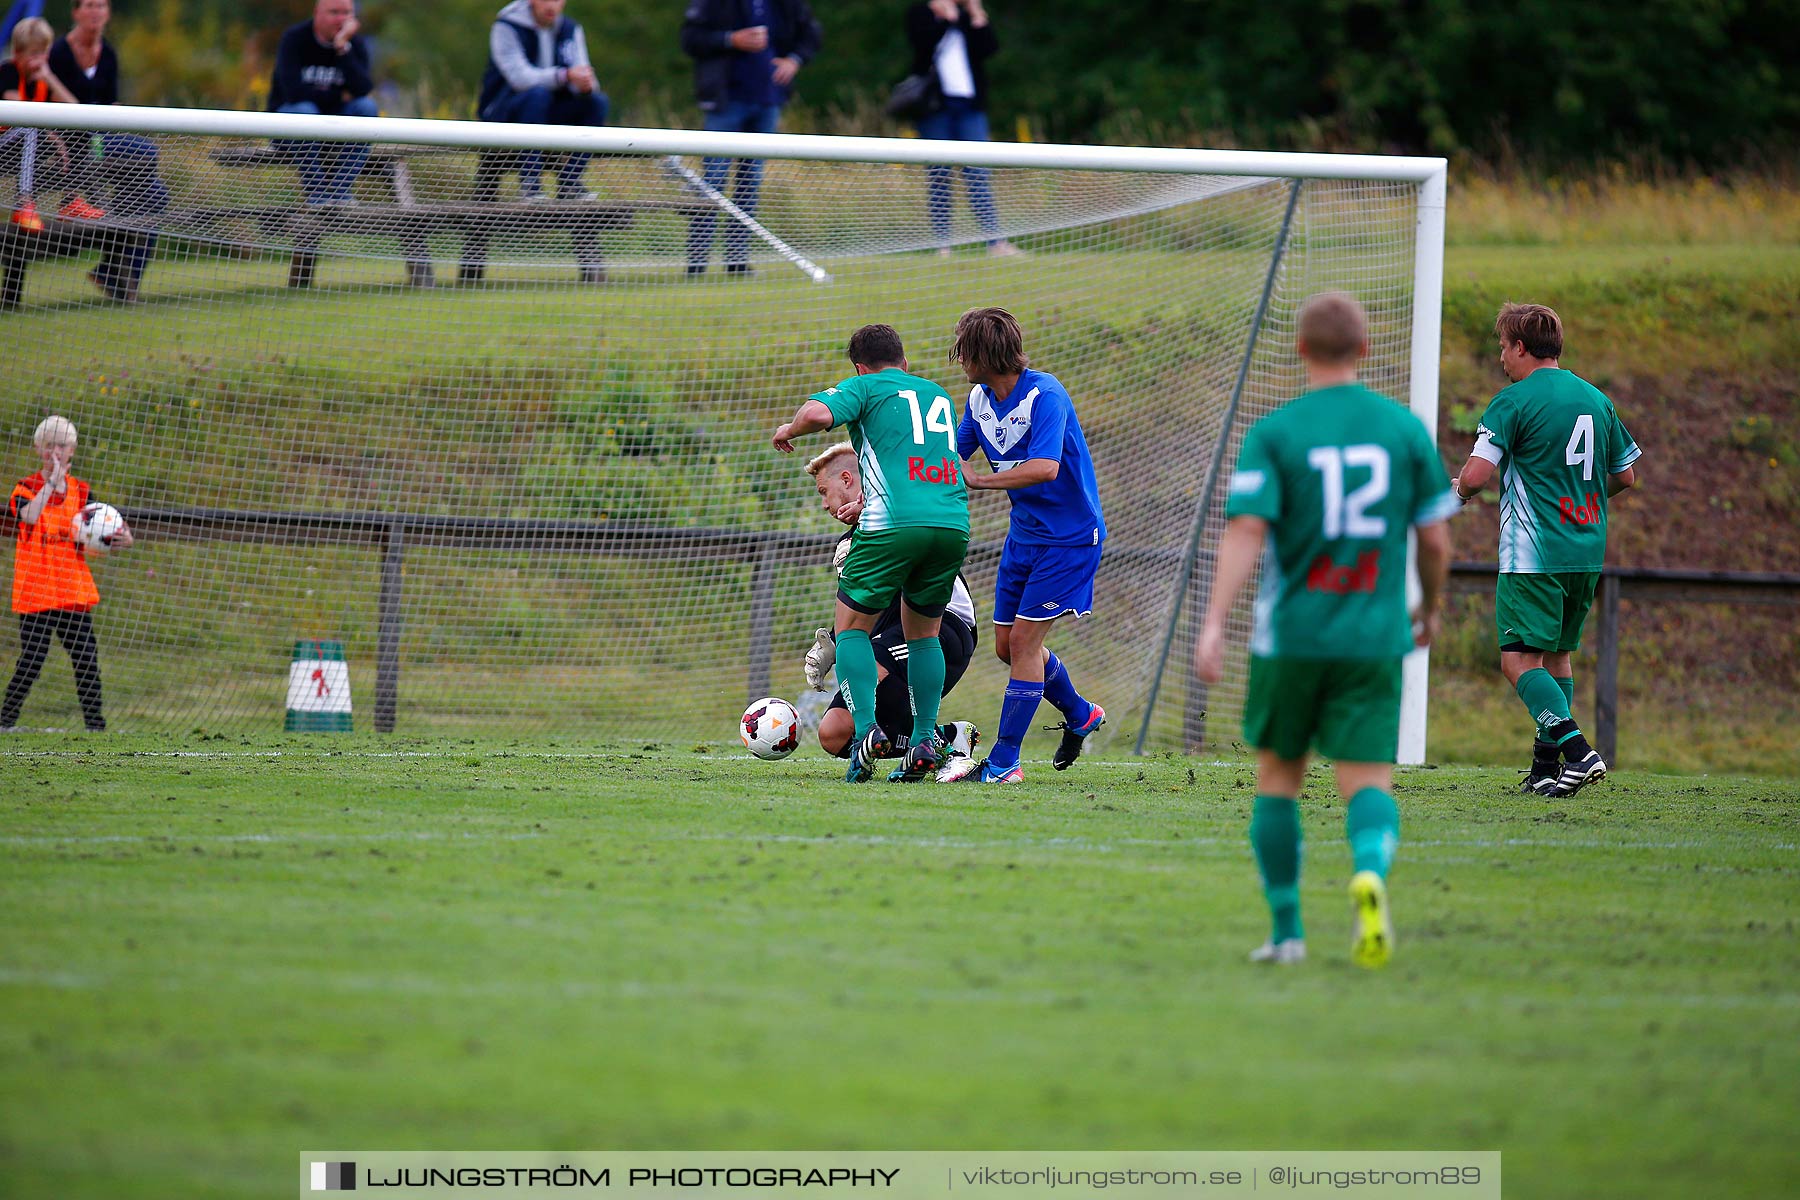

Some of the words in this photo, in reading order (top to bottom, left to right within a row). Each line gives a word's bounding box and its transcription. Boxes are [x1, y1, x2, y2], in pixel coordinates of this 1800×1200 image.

[897, 389, 957, 453] 14
[1565, 414, 1595, 481] 4
[908, 456, 959, 486] Rolf
[1309, 445, 1389, 538] 12
[1559, 492, 1601, 526] Rolf
